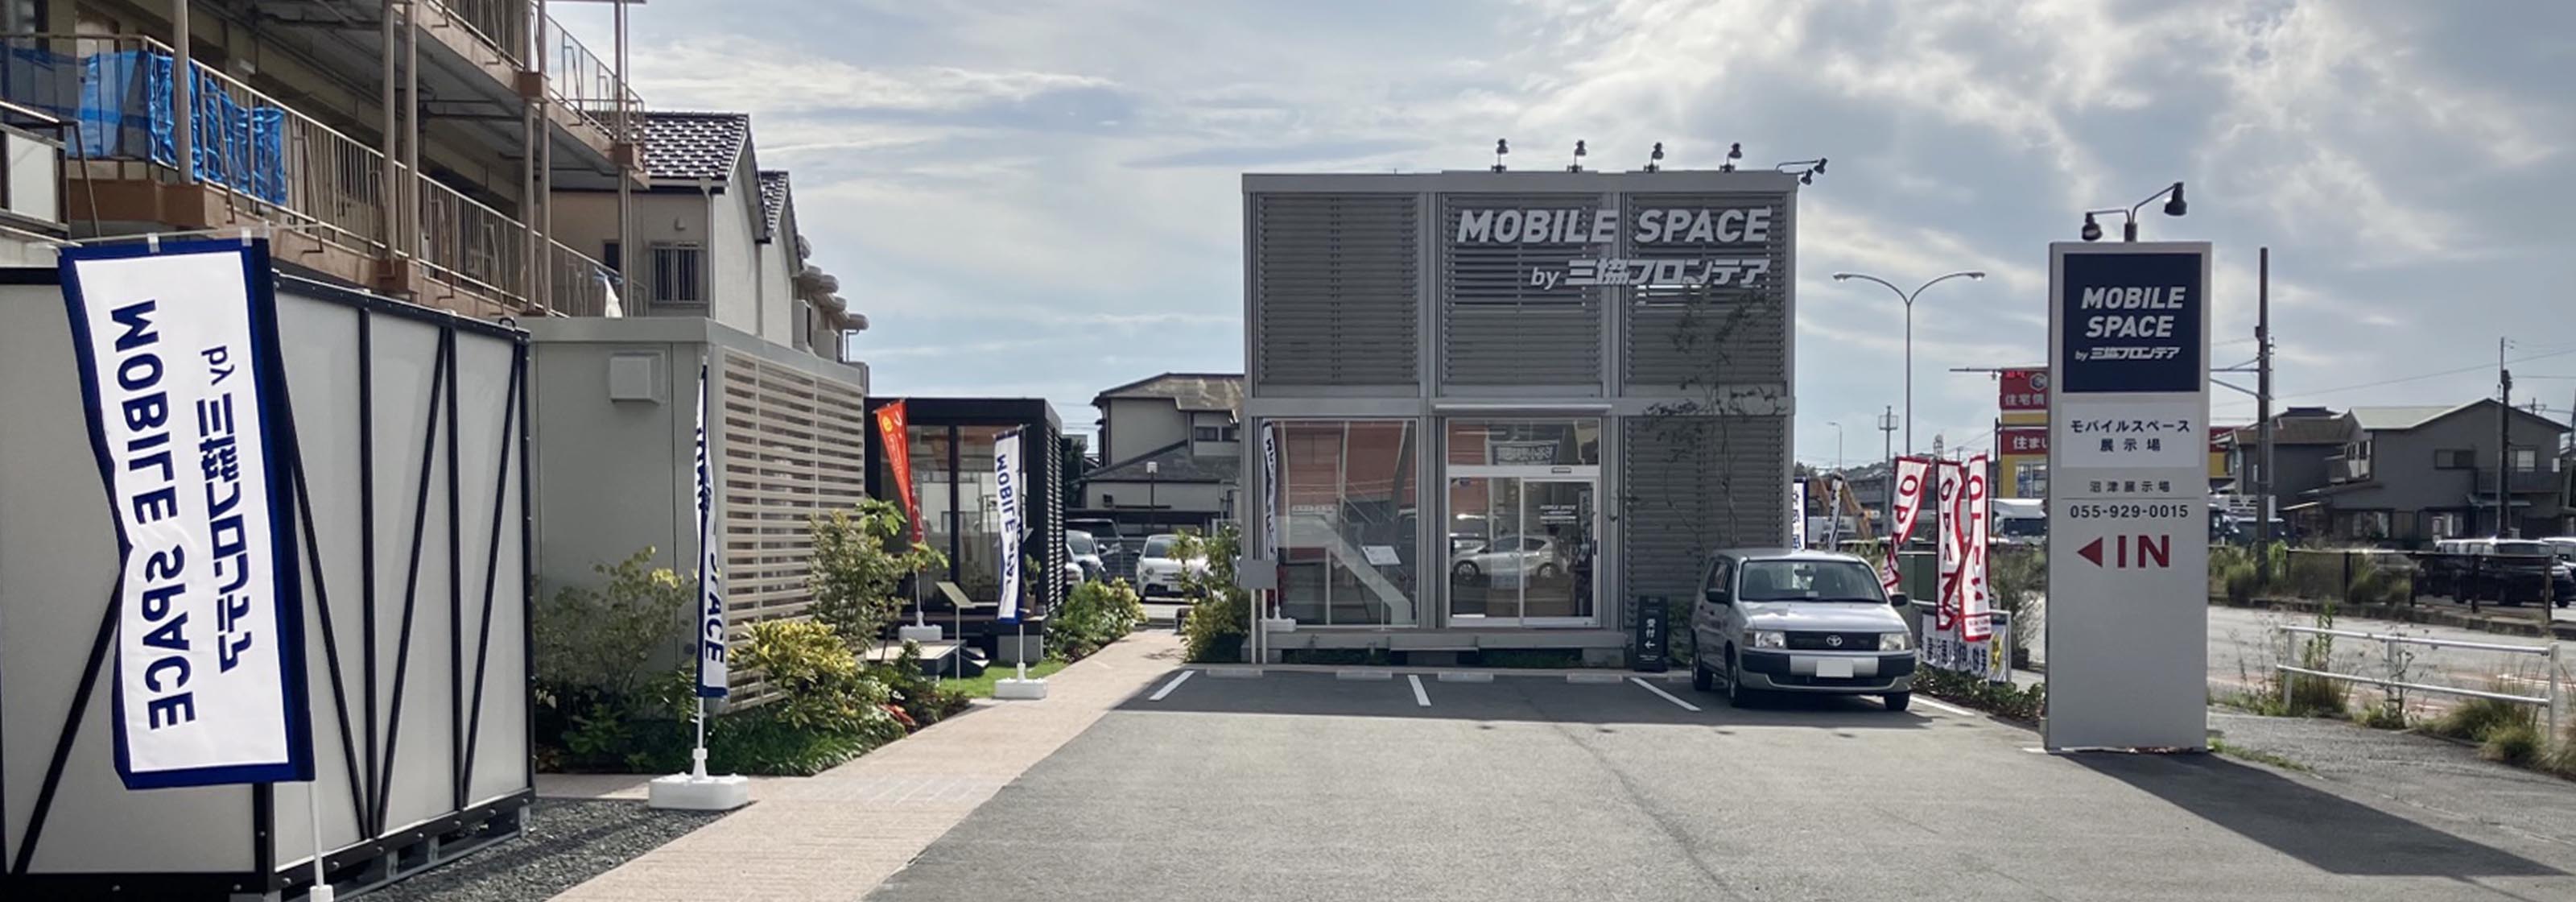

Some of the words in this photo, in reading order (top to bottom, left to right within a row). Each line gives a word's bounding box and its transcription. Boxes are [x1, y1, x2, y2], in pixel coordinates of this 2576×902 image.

[1458, 209, 1618, 242] MOBILE
[1635, 207, 1771, 242] SPACE
[1530, 267, 1560, 290] by
[1565, 259, 1770, 286] 三協フロンテア
[2081, 287, 2186, 309] MOBILE
[2085, 316, 2174, 337] SPACE
[2074, 350, 2089, 362] by
[2070, 420, 2190, 433] モバイルスペース
[2099, 438, 2161, 452] 展示場
[2090, 481, 2170, 493] 沼津展示場
[2070, 505, 2189, 519] 055-929-0015
[2117, 535, 2169, 569] IN
